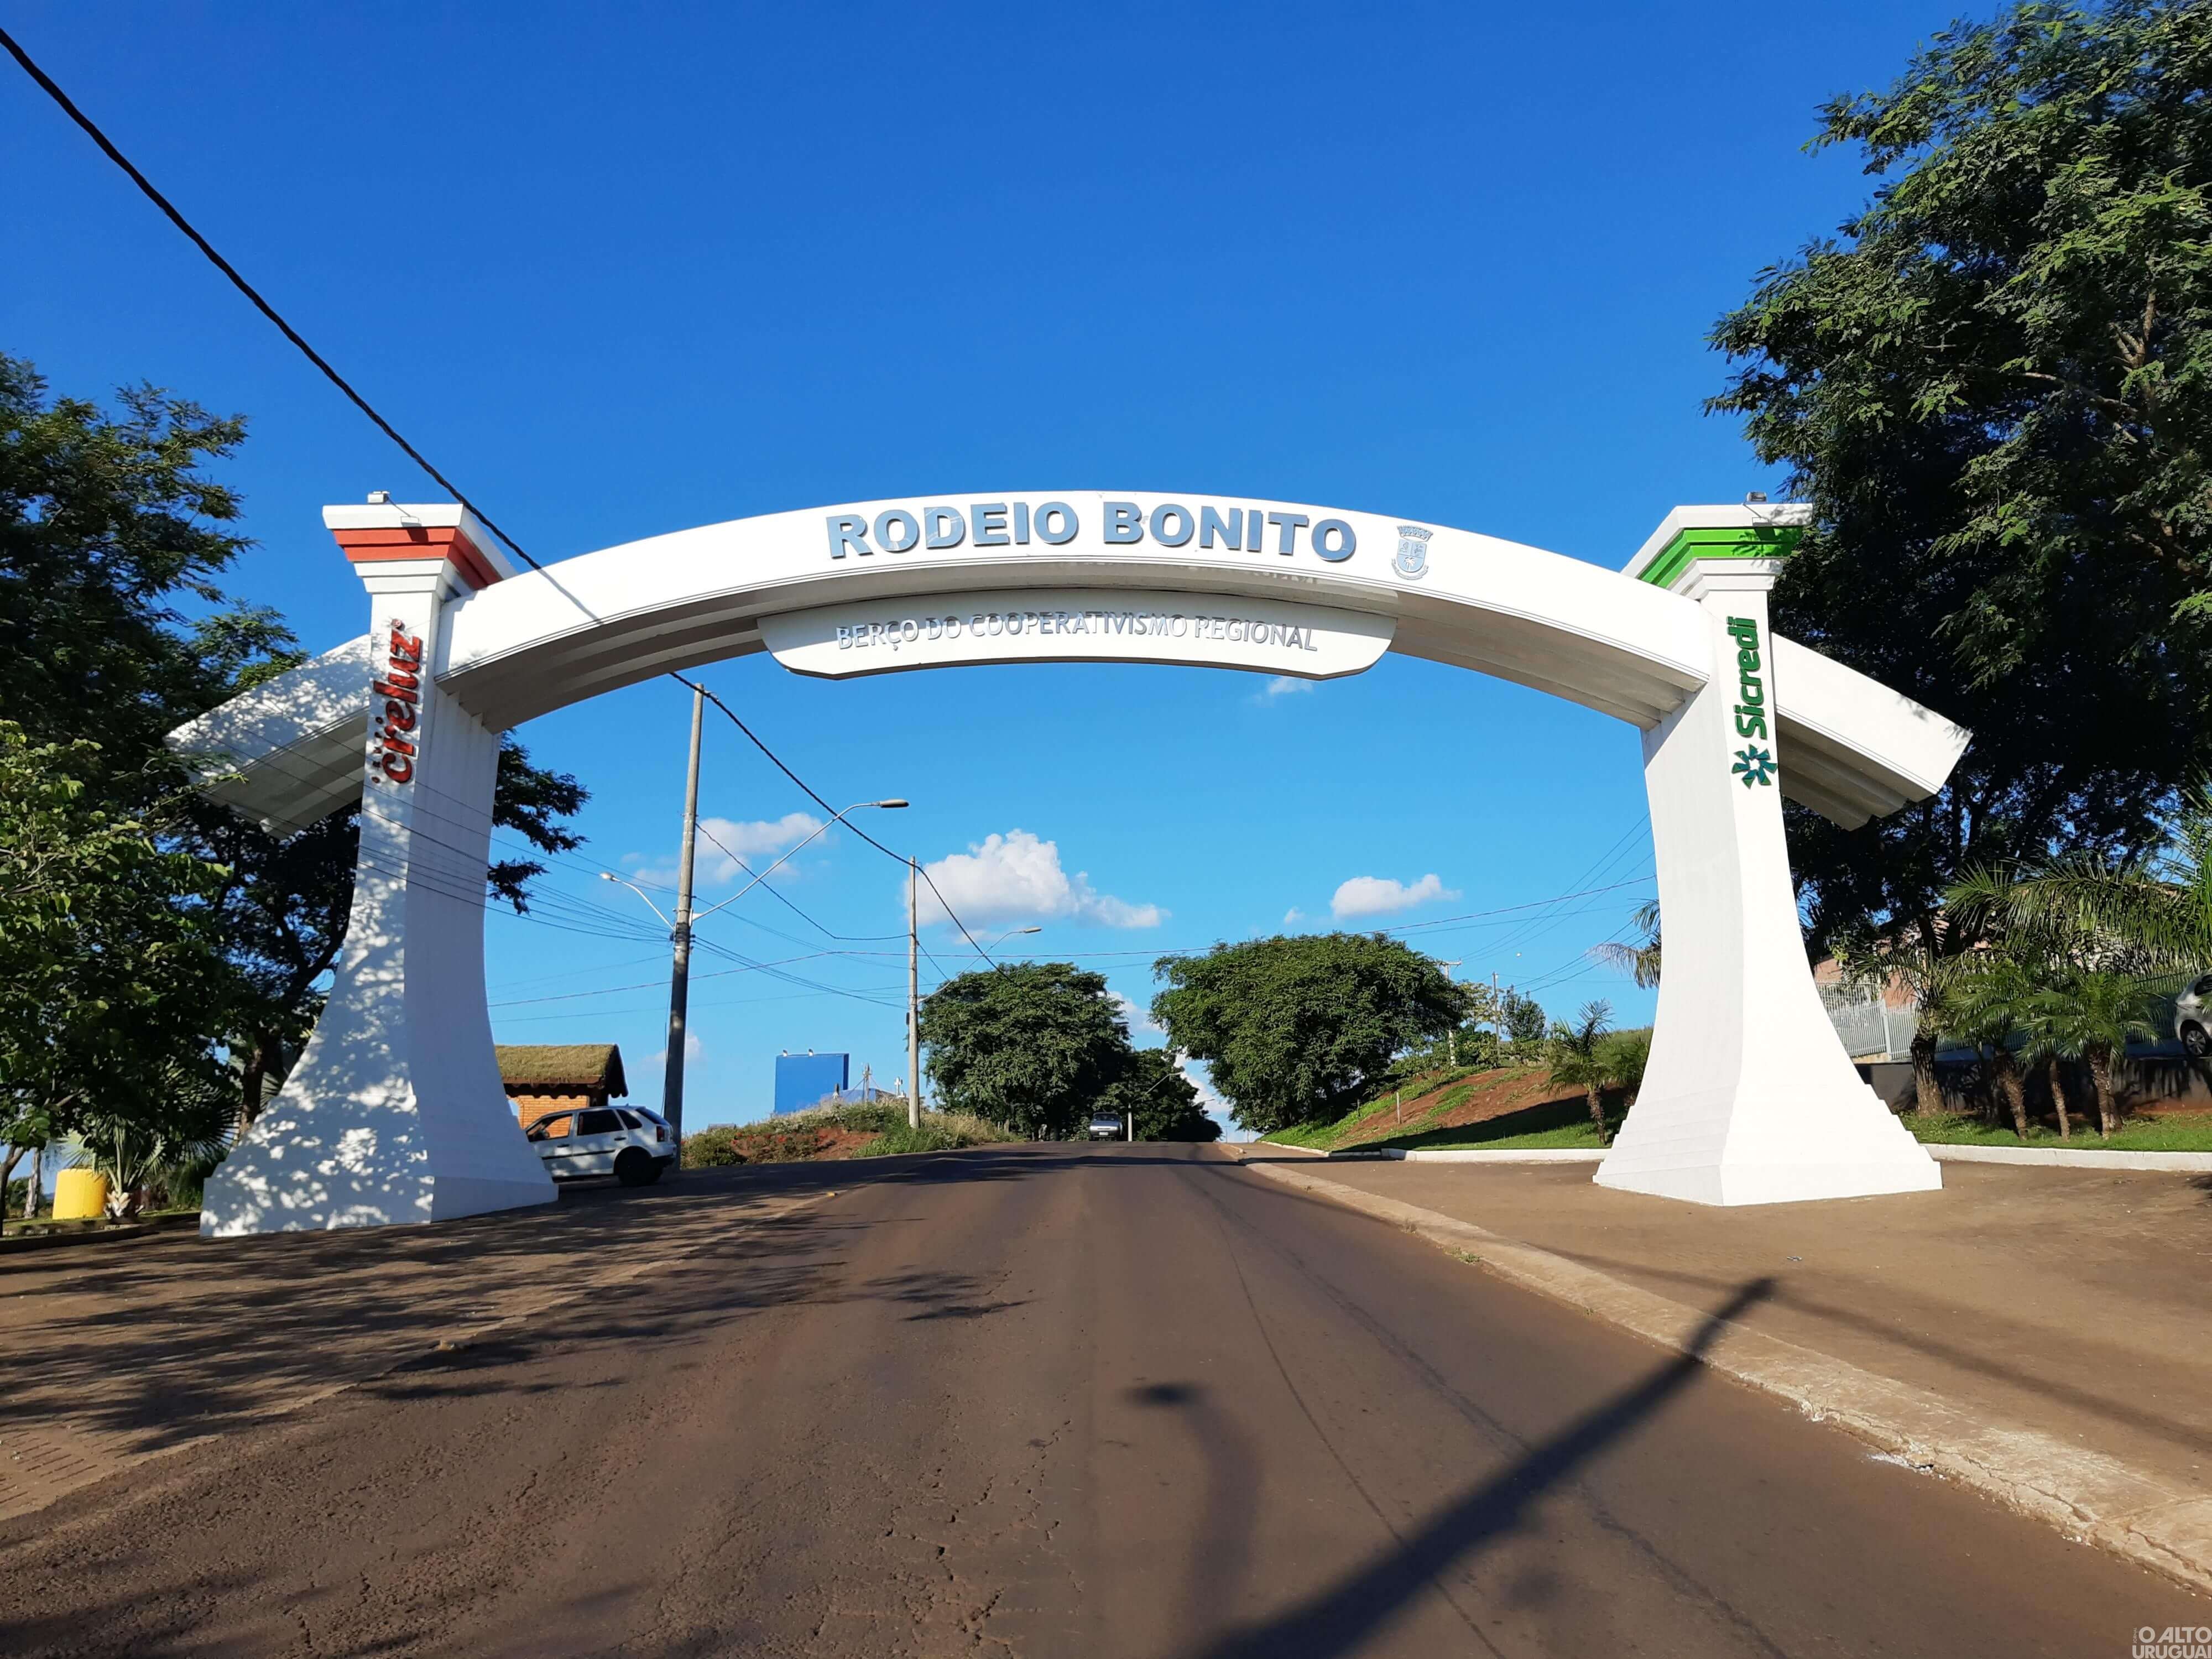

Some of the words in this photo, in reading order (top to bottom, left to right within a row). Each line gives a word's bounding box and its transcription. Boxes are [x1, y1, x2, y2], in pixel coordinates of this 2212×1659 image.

[826, 502, 1078, 558] RODEIO
[1103, 502, 1357, 561] BONITO
[835, 619, 919, 651] BERÇO
[926, 615, 962, 640] DO
[969, 611, 1187, 637] COOPERATIVISMO
[1194, 615, 1318, 651] REGIONAL
[373, 629, 421, 784] creluz
[1726, 616, 1767, 740] Sicredi
